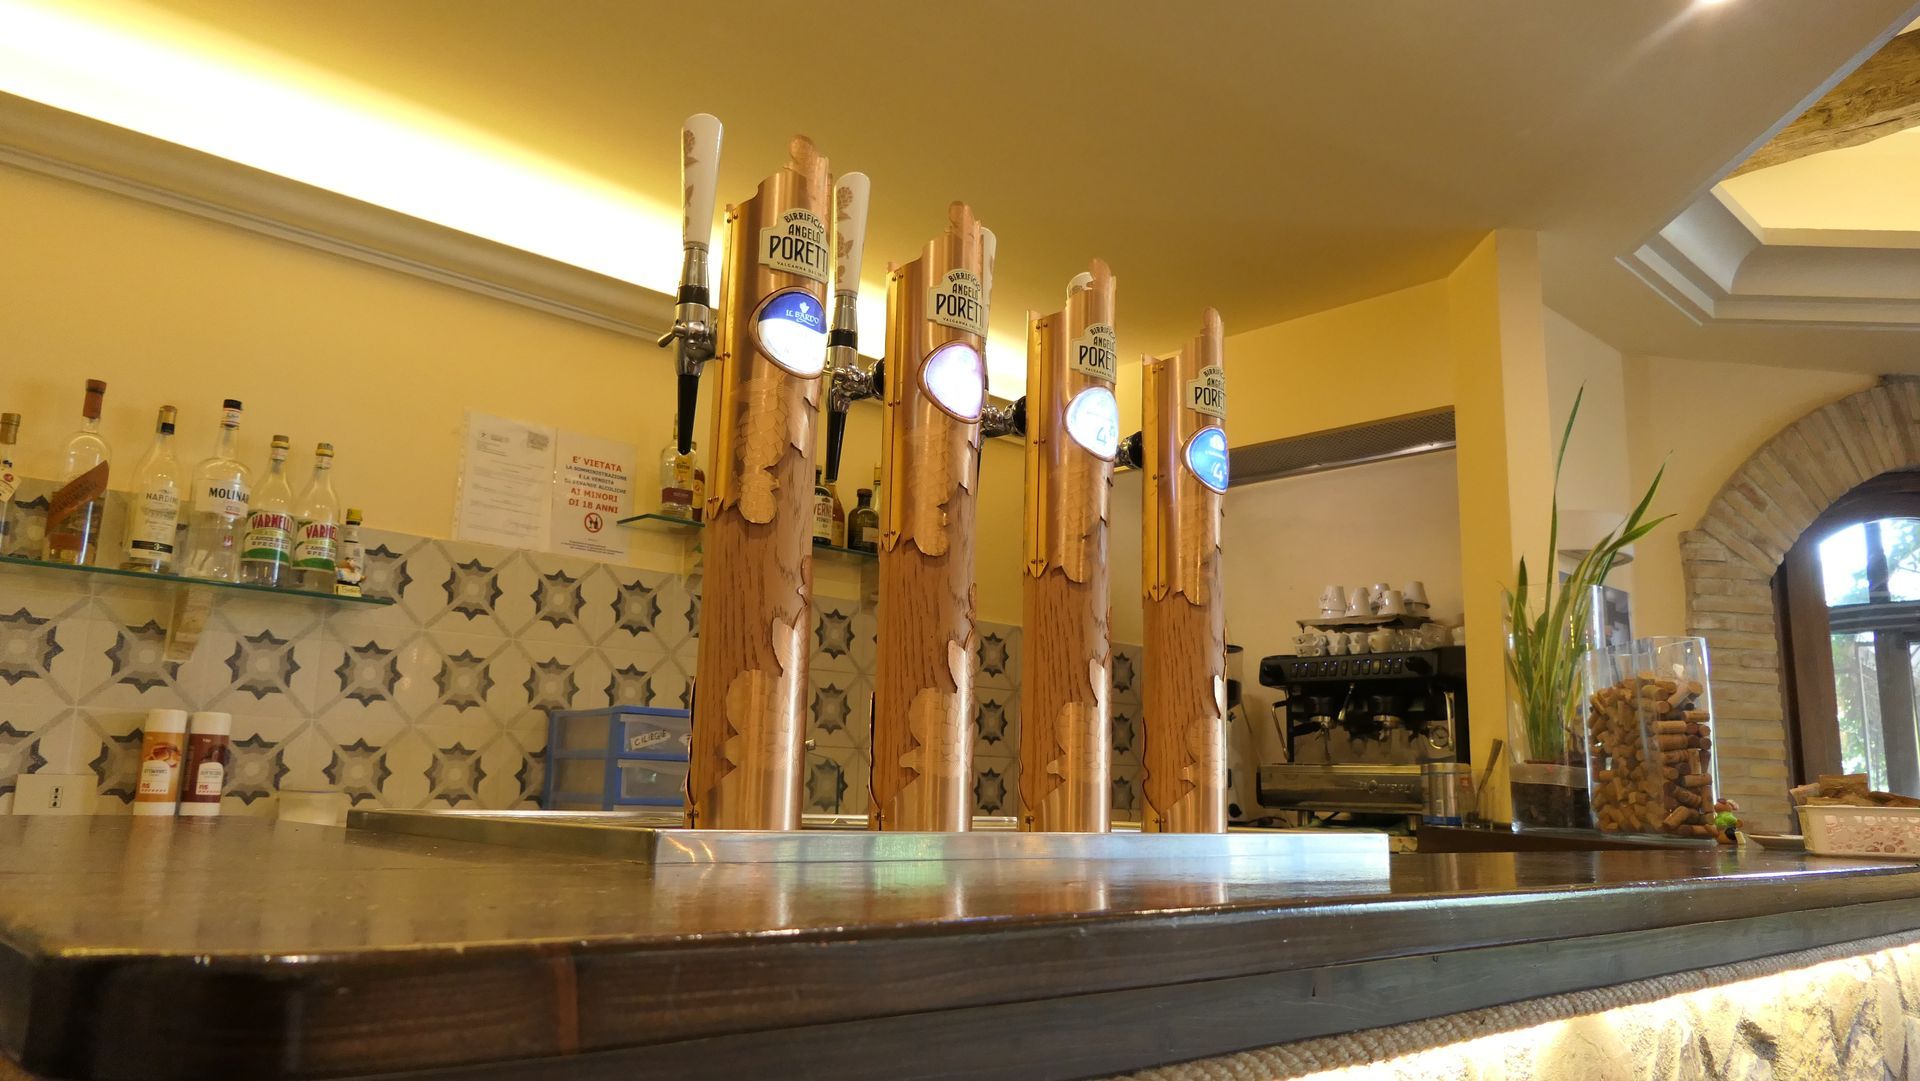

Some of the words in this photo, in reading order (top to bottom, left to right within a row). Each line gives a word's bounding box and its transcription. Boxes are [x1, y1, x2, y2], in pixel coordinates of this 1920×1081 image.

[784, 212, 825, 234] BIRRIFICIO
[788, 223, 821, 243] ANGELO
[952, 283, 979, 300] ANGELO
[936, 293, 984, 328] PORETT
[583, 458, 622, 472] VIETATA
[571, 487, 581, 496] AI
[584, 489, 618, 503] MINORI
[568, 498, 579, 507] DI
[582, 500, 593, 510] 18
[595, 503, 618, 514] ANNI
